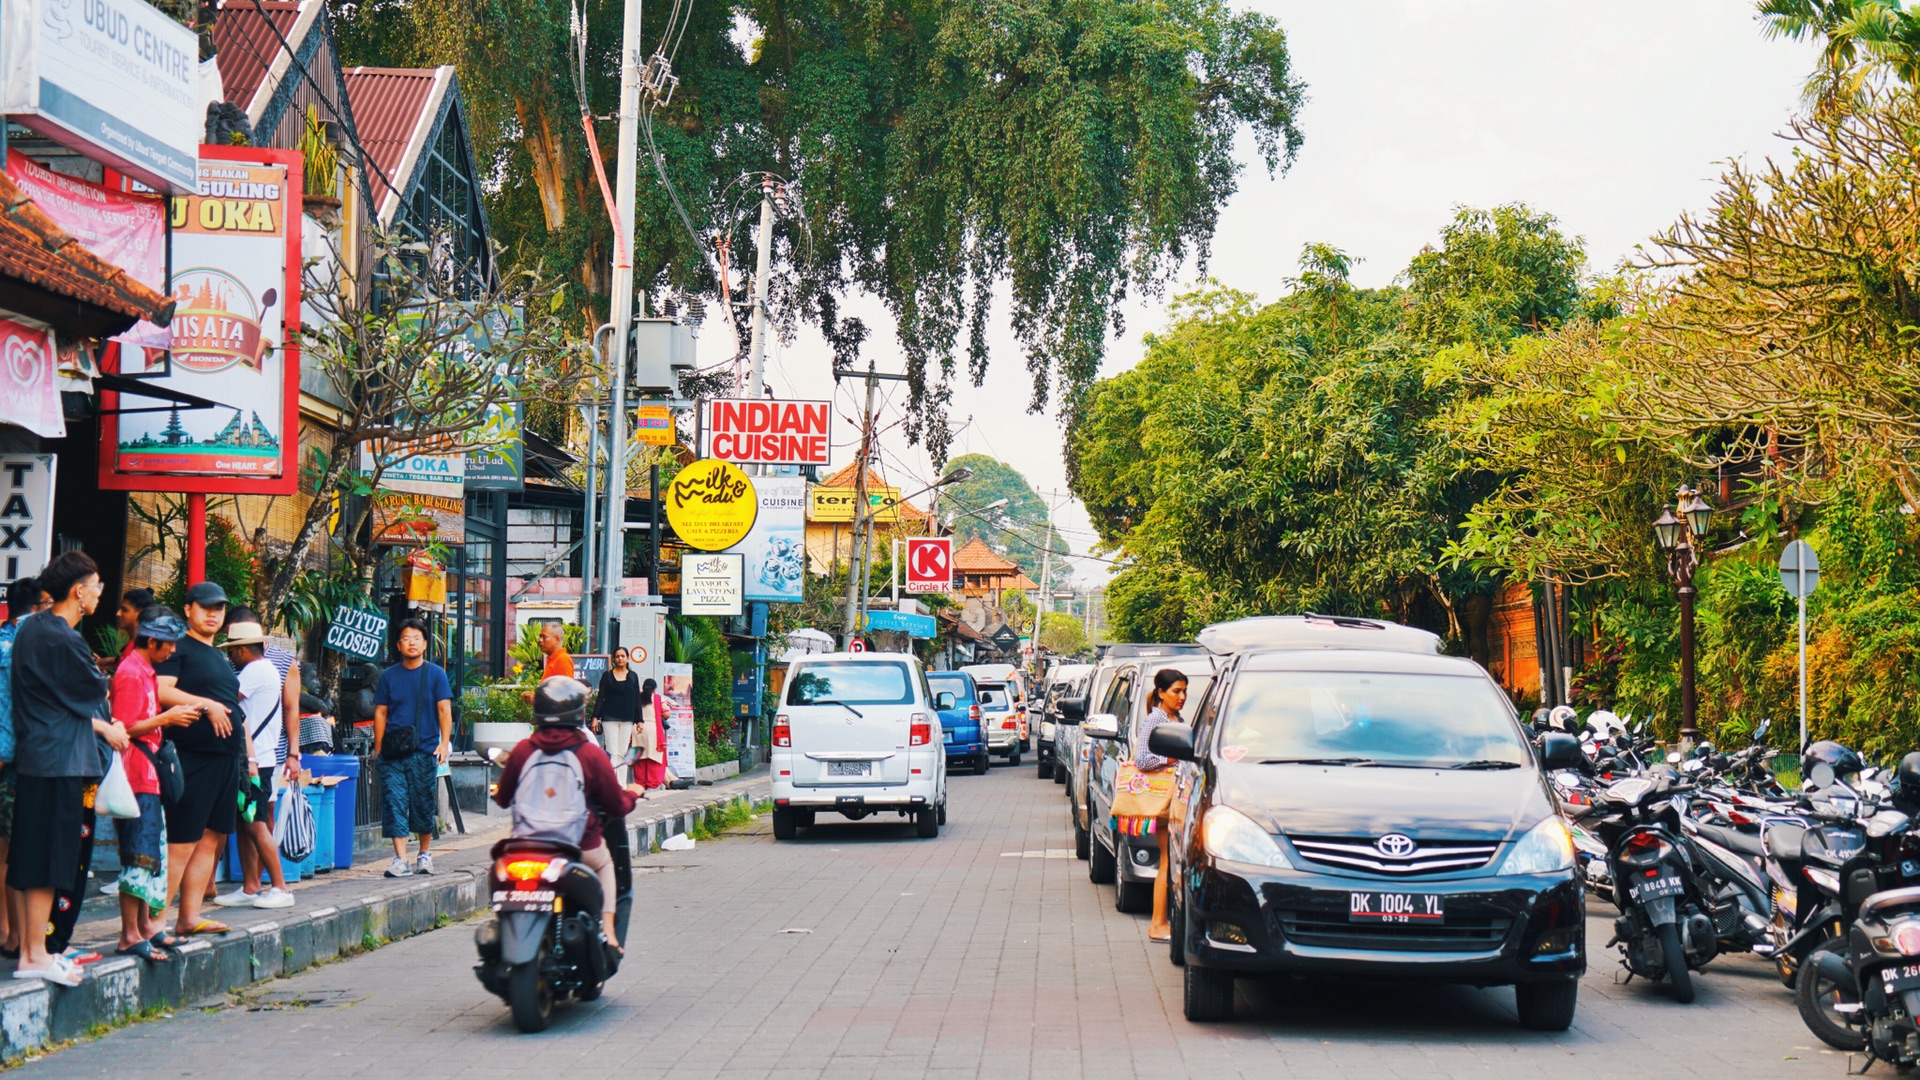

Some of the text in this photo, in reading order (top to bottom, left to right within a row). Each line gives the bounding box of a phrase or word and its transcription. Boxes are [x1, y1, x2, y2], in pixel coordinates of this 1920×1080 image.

[84, 0, 190, 84] UBUD CENTRE
[211, 169, 249, 180] MAKAN
[57, 174, 107, 204] INFORMATION
[199, 181, 280, 201] GULING
[57, 195, 102, 220] FOLLOWING
[101, 210, 137, 230] SERVICE
[200, 199, 276, 232] OKA
[189, 355, 226, 363] HONDA
[713, 402, 828, 434] INDIAN
[713, 433, 827, 462] CUISINE
[215, 460, 257, 470] One HEART.
[411, 457, 450, 473] OKA
[732, 480, 747, 499] &
[413, 494, 433, 507] BABI
[434, 498, 464, 513] GULING
[762, 498, 804, 507] CUISINE
[0, 462, 33, 581] TAXI
[908, 582, 950, 591] Circle K
[335, 604, 387, 635] TUTUP
[869, 617, 929, 630] Tourist Service
[327, 625, 380, 658] CLOSED
[1629, 886, 1640, 898] DK
[1668, 876, 1682, 887] KK
[1351, 893, 1443, 914] DK 1004 YL
[1881, 964, 1920, 982] DK 26
